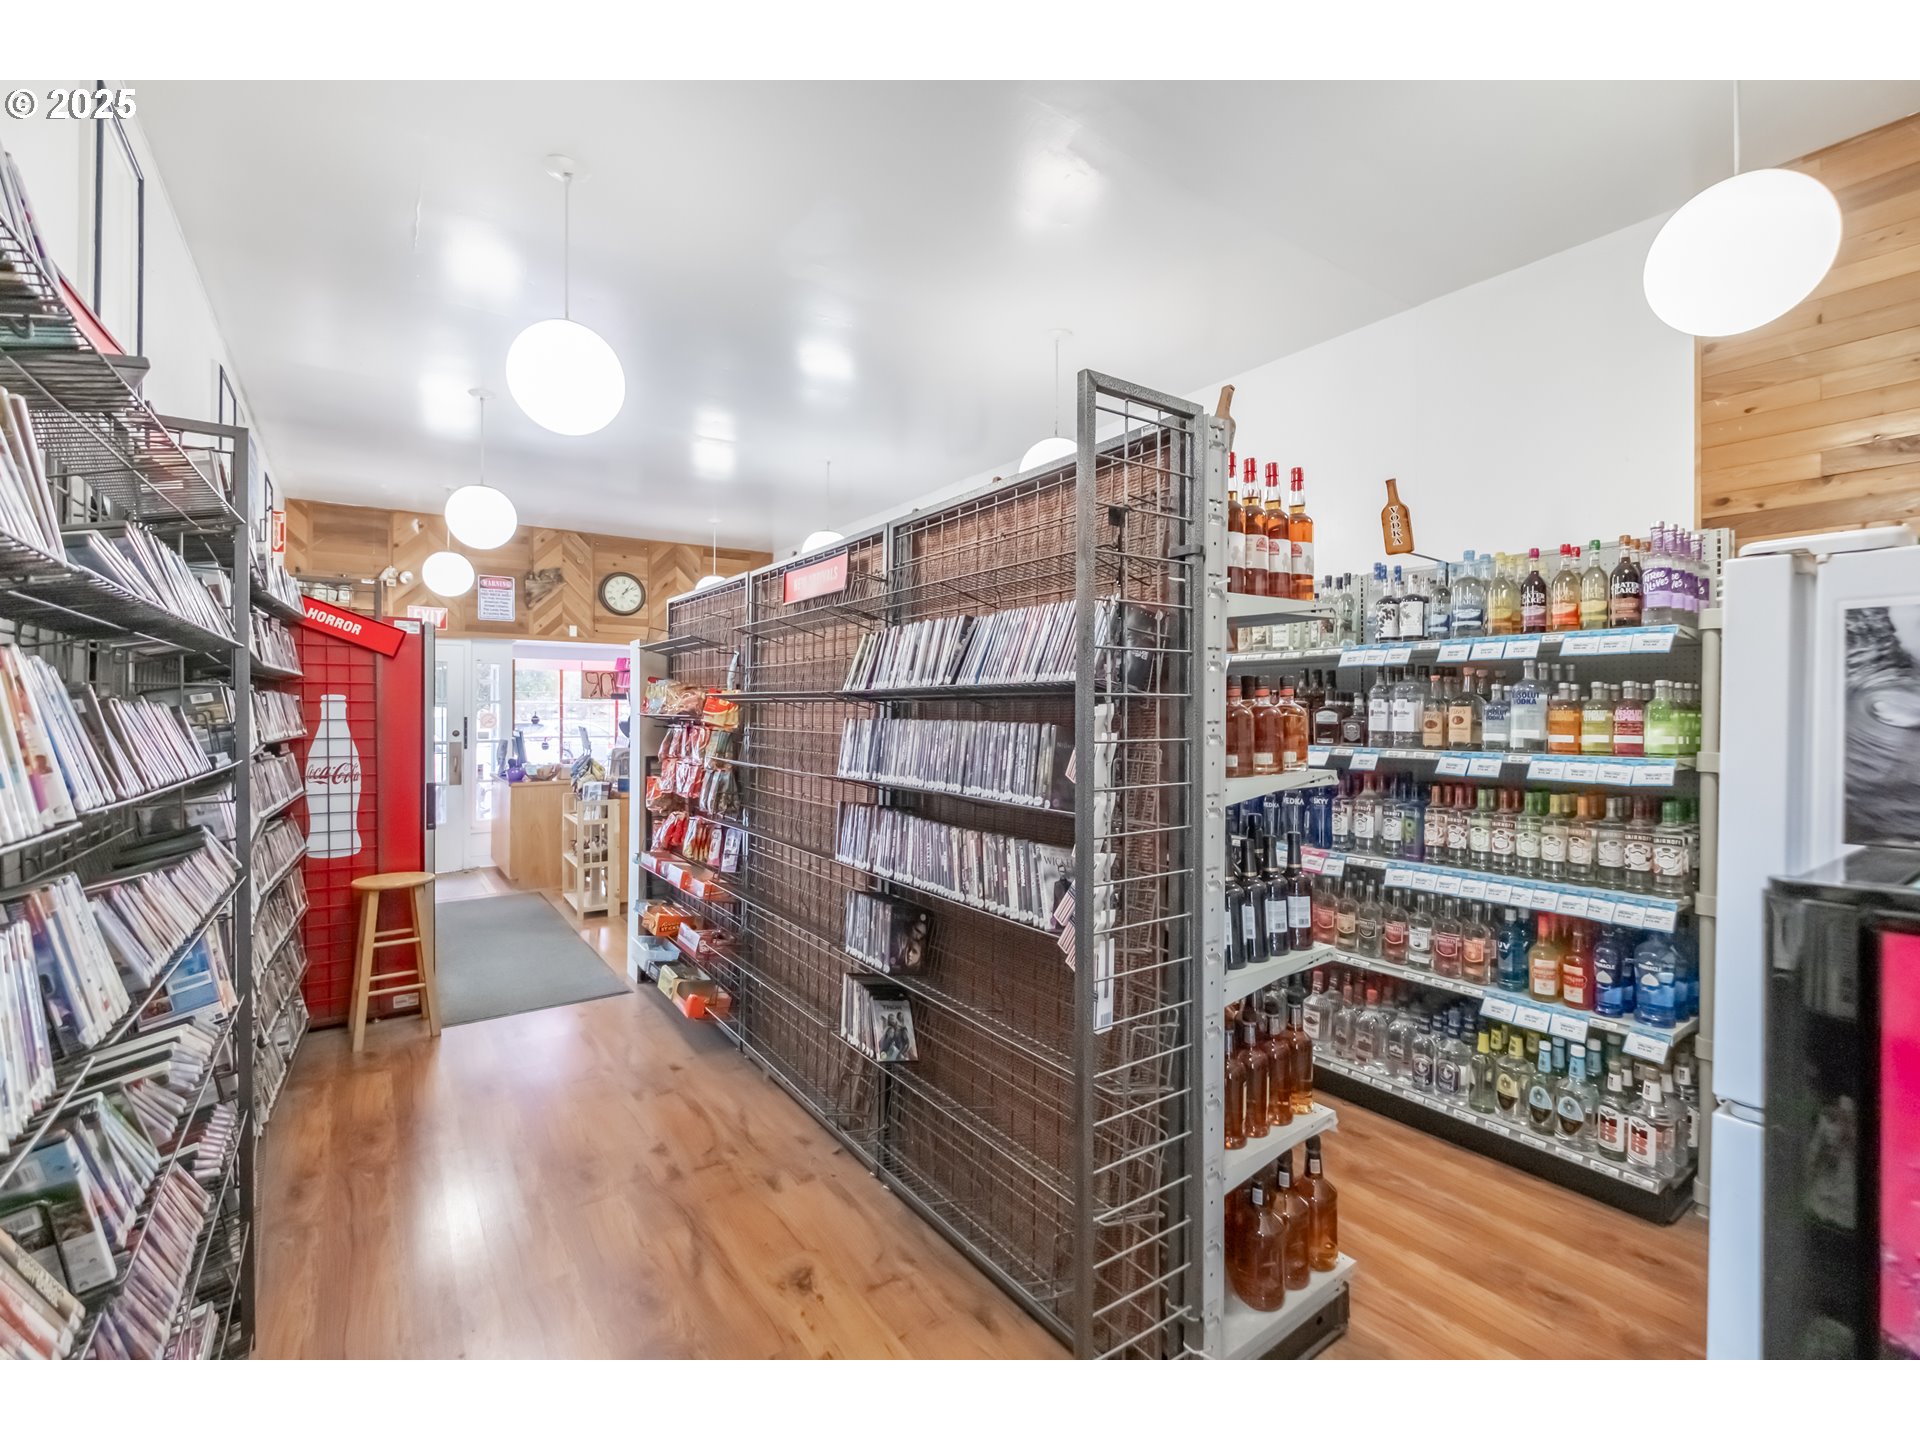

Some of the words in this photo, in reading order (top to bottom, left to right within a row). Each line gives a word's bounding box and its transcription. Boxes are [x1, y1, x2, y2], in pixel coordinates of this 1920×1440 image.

[1389, 505, 1403, 546] VODKA
[306, 608, 362, 635] HORROR
[413, 608, 446, 627] EXIT
[307, 762, 360, 784] Coca-Cola
[1313, 797, 1329, 805] SKYY
[1498, 942, 1511, 950] UV
[1638, 963, 1662, 972] PINNACLE
